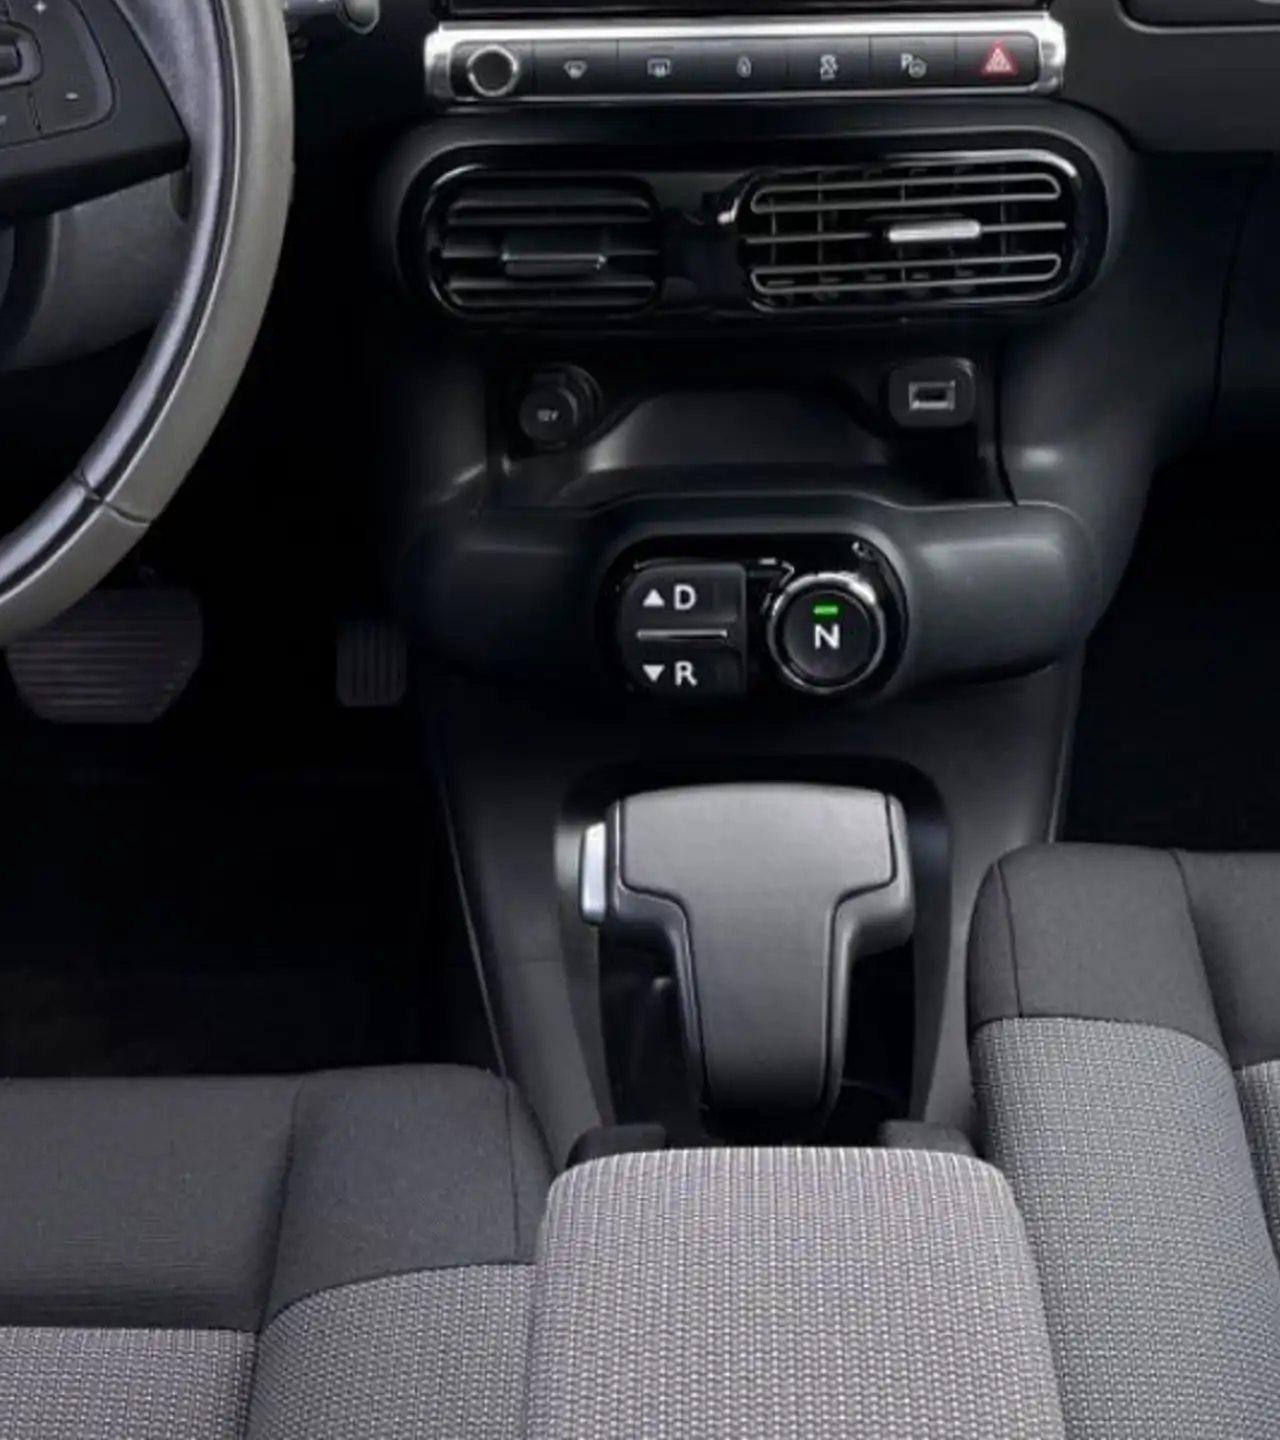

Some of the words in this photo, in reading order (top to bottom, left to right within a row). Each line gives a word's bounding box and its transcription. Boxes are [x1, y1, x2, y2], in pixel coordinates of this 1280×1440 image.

[674, 584, 697, 610] D
[814, 623, 840, 650] N
[675, 661, 697, 687] R
